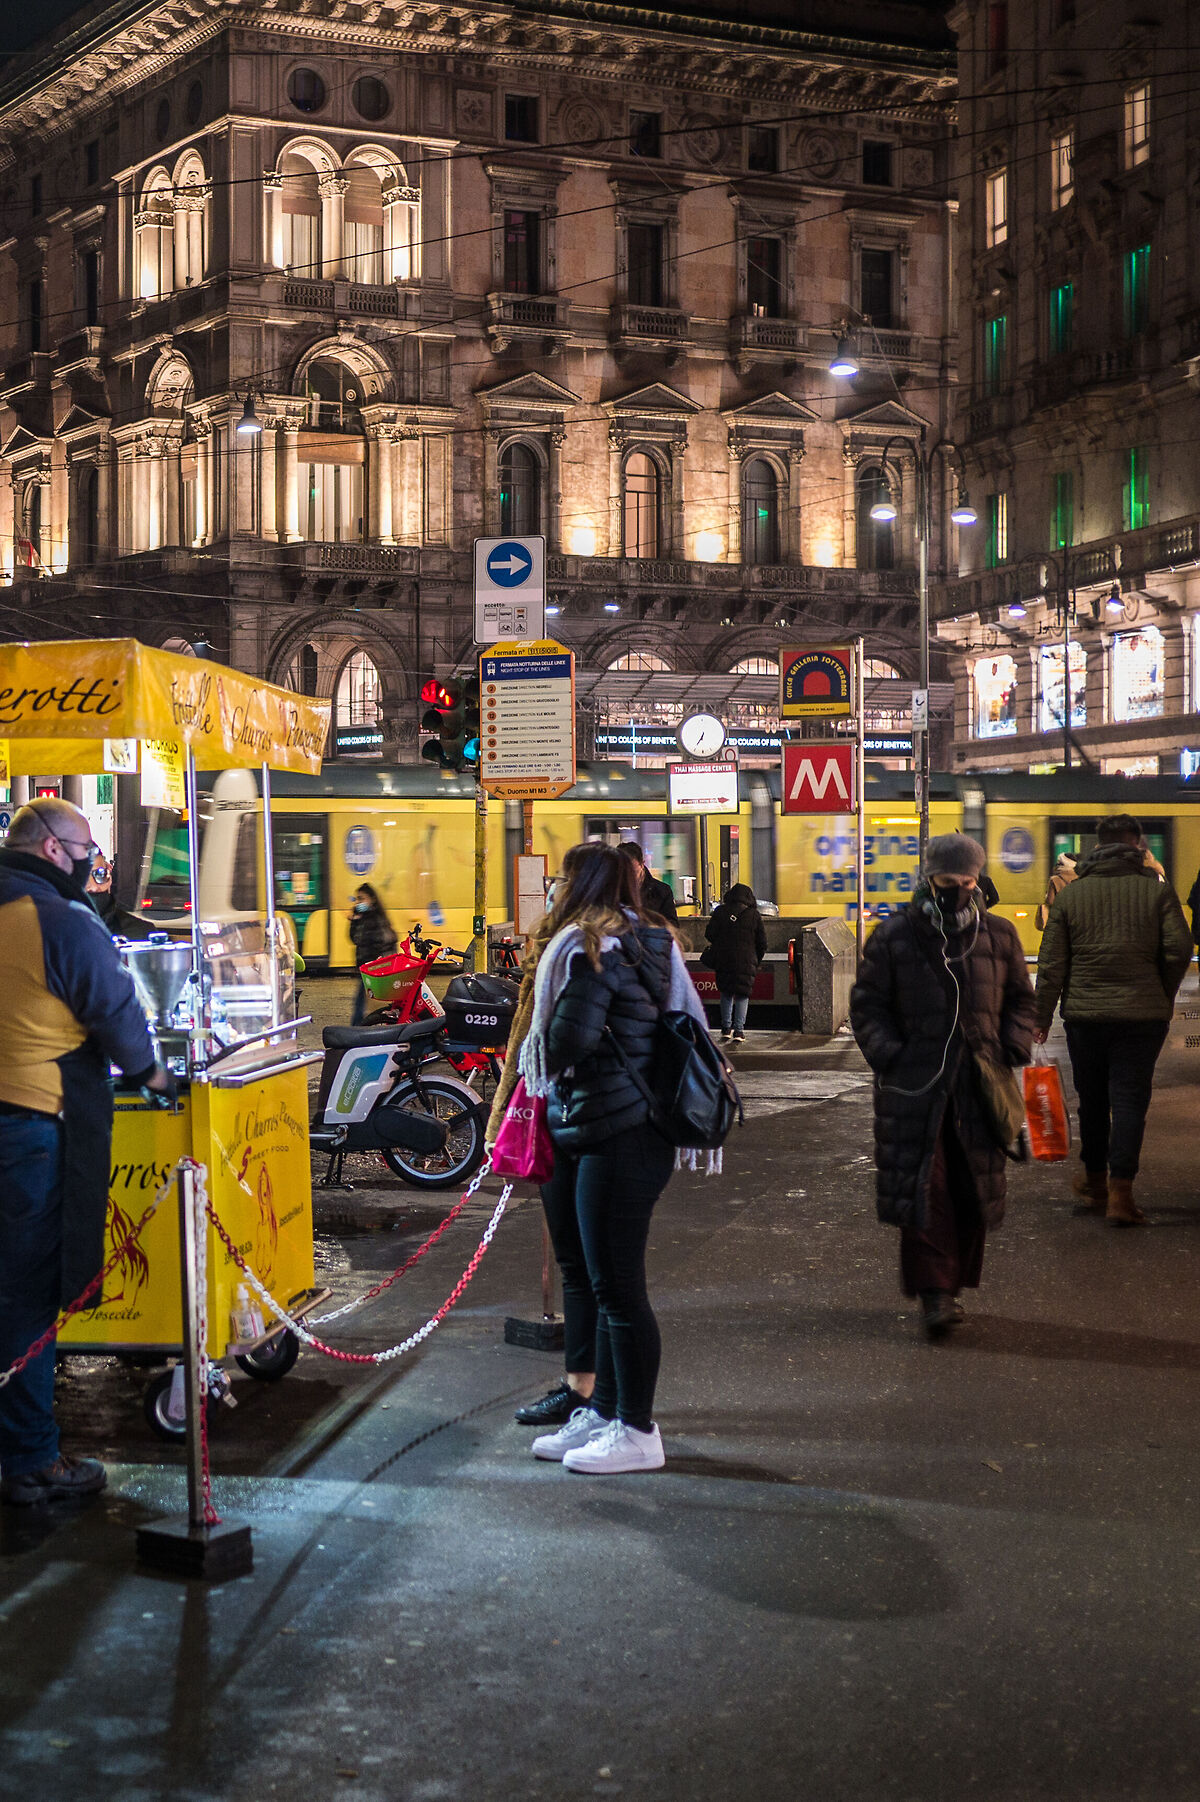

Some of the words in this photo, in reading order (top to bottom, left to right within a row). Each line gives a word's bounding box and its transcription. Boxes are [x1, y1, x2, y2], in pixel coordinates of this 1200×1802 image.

[790, 655, 819, 675] GALLERIA
[822, 656, 847, 697] SOTTERRANEA
[231, 689, 273, 751] Churros
[618, 736, 642, 744] COLORS
[651, 737, 677, 745] BENETTO
[738, 738, 761, 746] COLORS
[761, 738, 769, 746] OF
[790, 759, 849, 799] M
[814, 828, 920, 865] origina
[465, 1014, 498, 1026] 0229
[109, 1159, 171, 1191] rros
